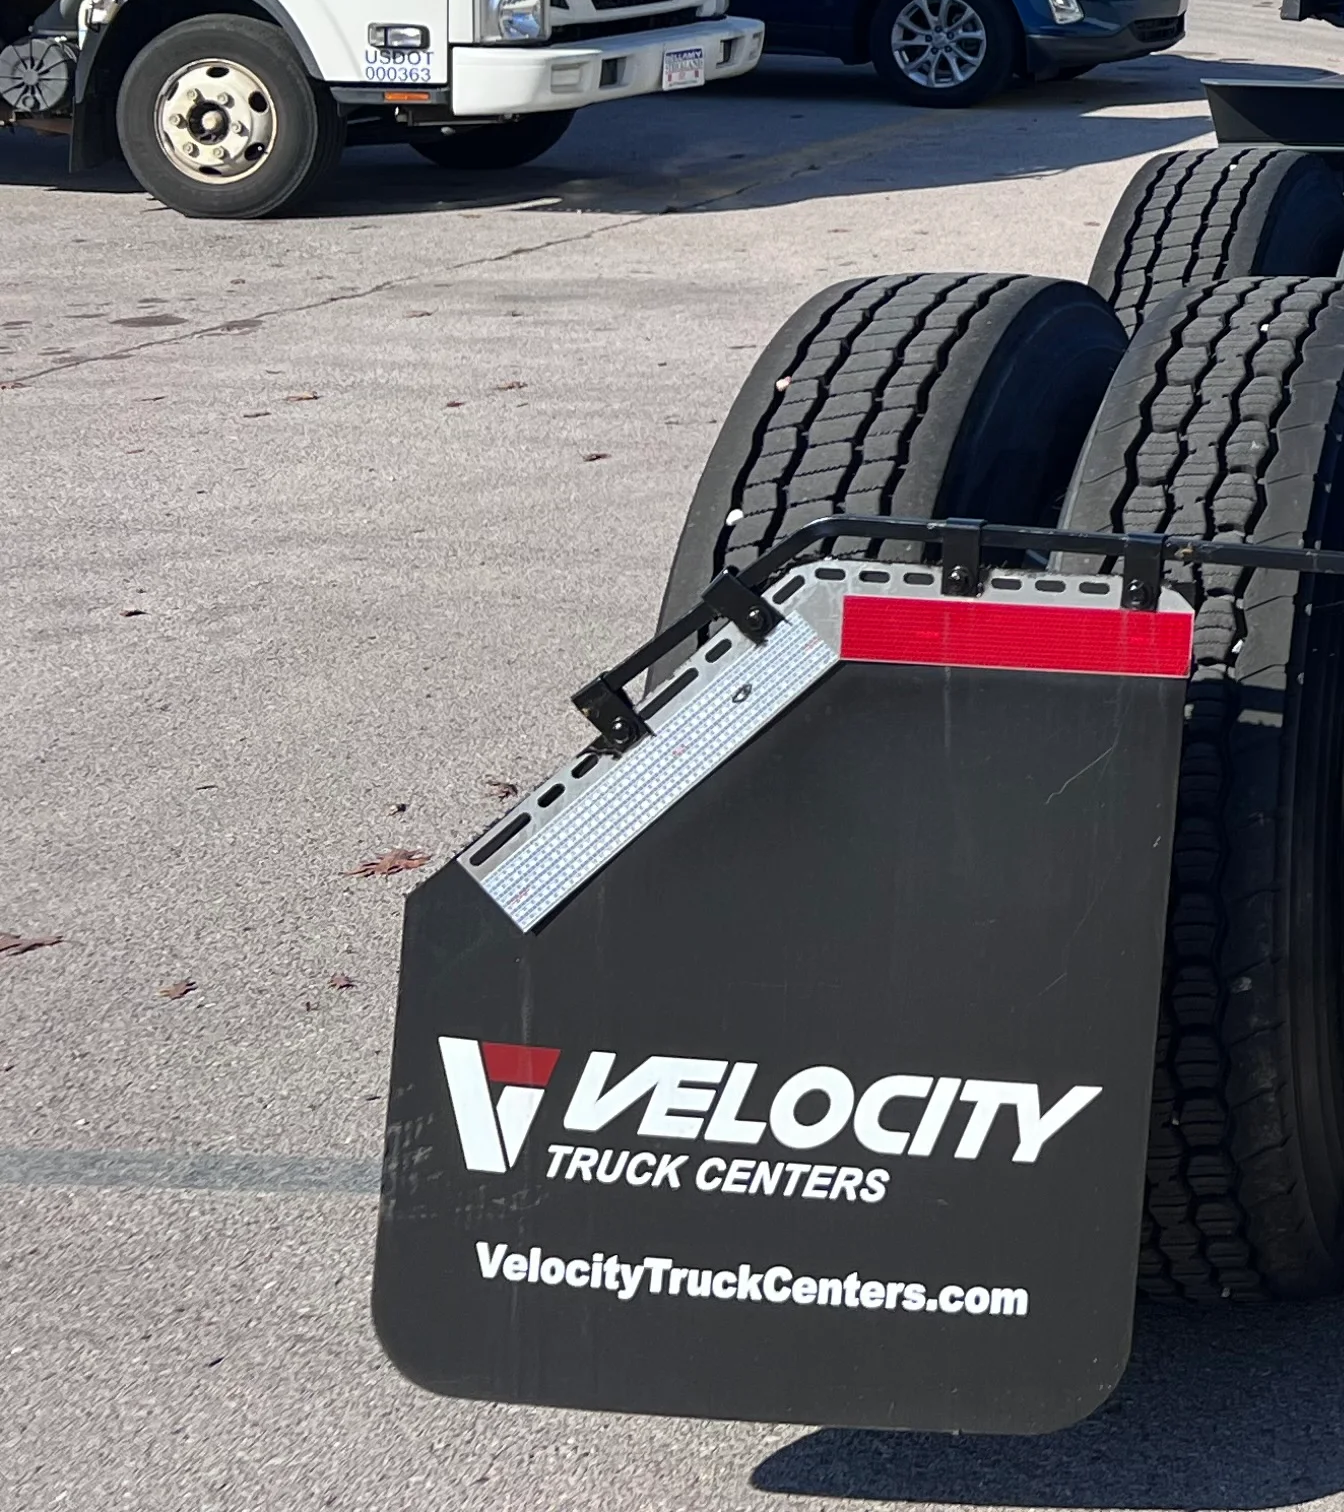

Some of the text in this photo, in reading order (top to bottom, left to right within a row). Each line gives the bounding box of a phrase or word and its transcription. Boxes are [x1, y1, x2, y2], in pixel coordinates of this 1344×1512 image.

[364, 49, 435, 66] USDOT
[365, 66, 432, 83] 000363
[562, 1050, 1103, 1164] VELOCITY
[543, 1143, 891, 1204] TRUCK CENTERS
[474, 1240, 1030, 1317] VelocityTruckCenters.com
